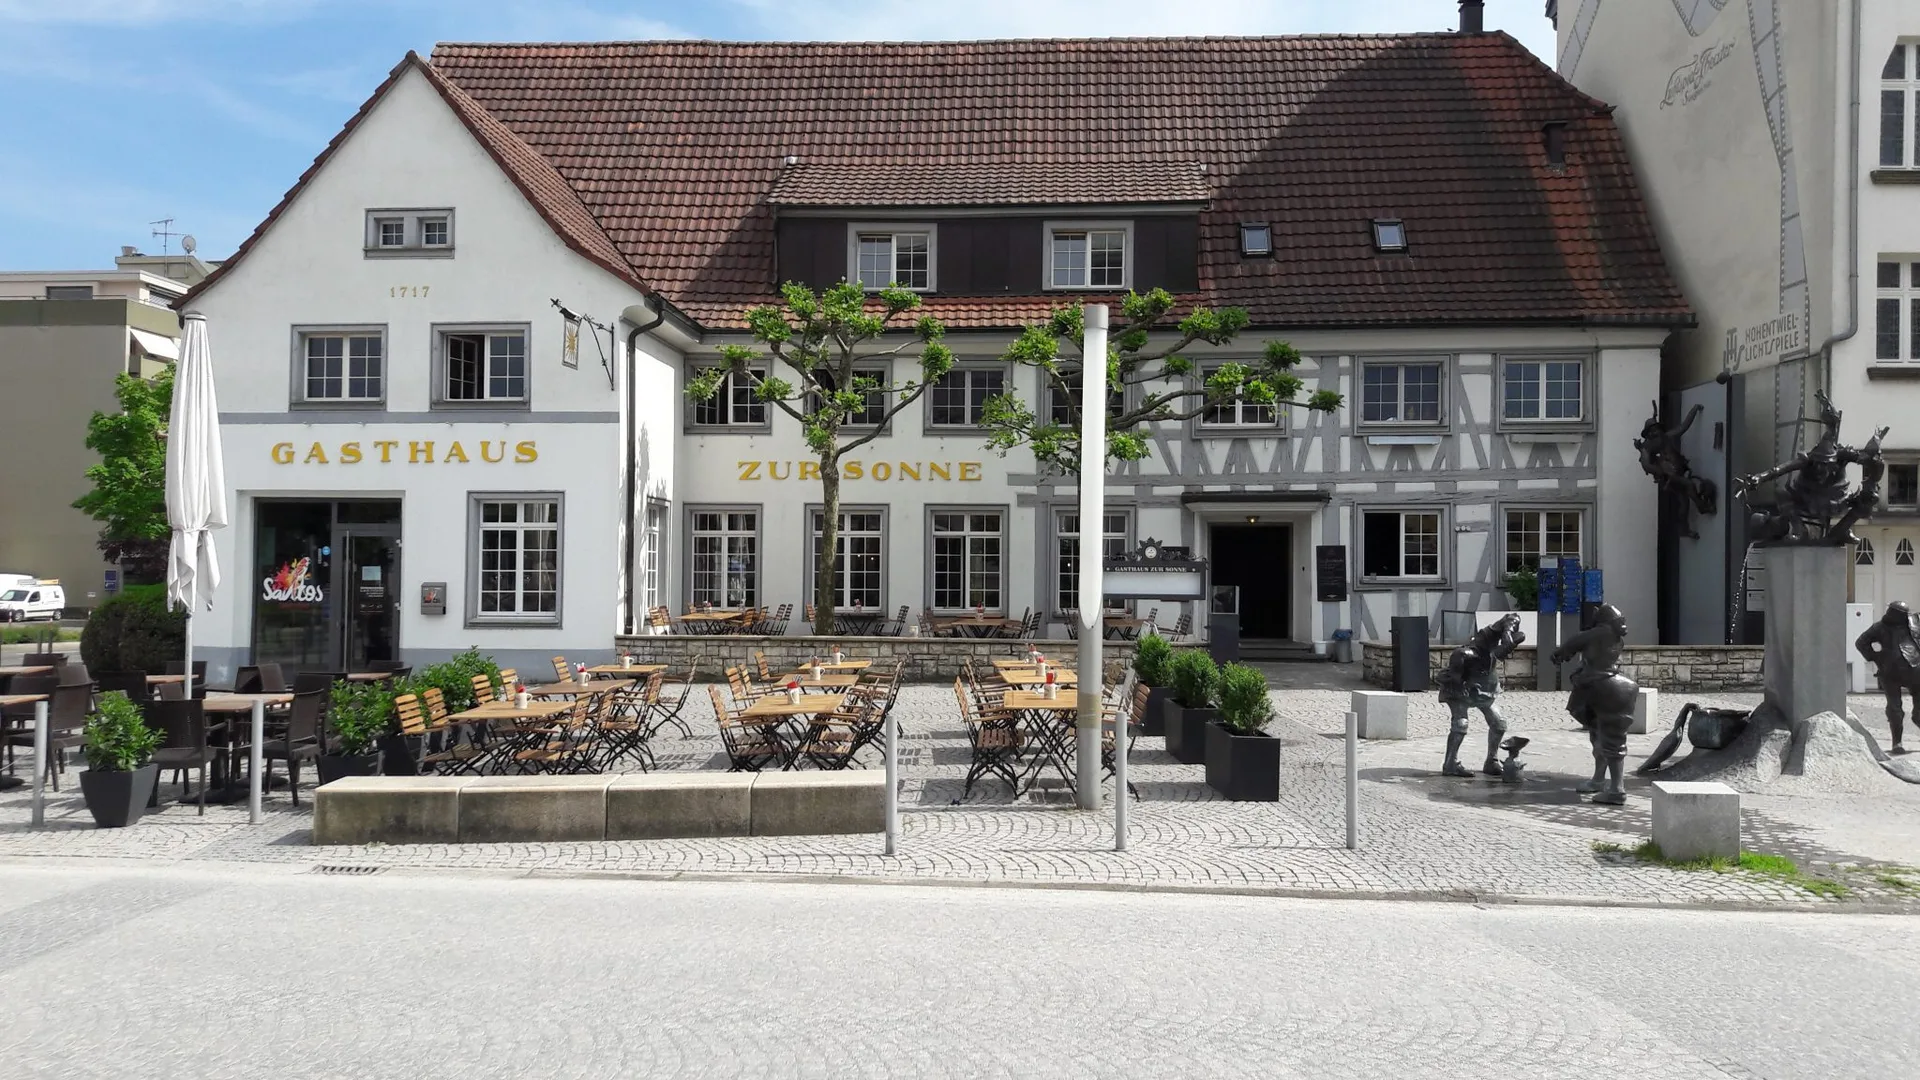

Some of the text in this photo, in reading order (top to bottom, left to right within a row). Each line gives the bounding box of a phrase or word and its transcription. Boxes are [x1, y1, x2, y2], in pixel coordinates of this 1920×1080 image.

[390, 285, 430, 298] 1717
[1745, 331, 1799, 362] LICHTSPIELE
[271, 440, 539, 465] GASTHAUS
[738, 460, 983, 482] ZUR SONNE
